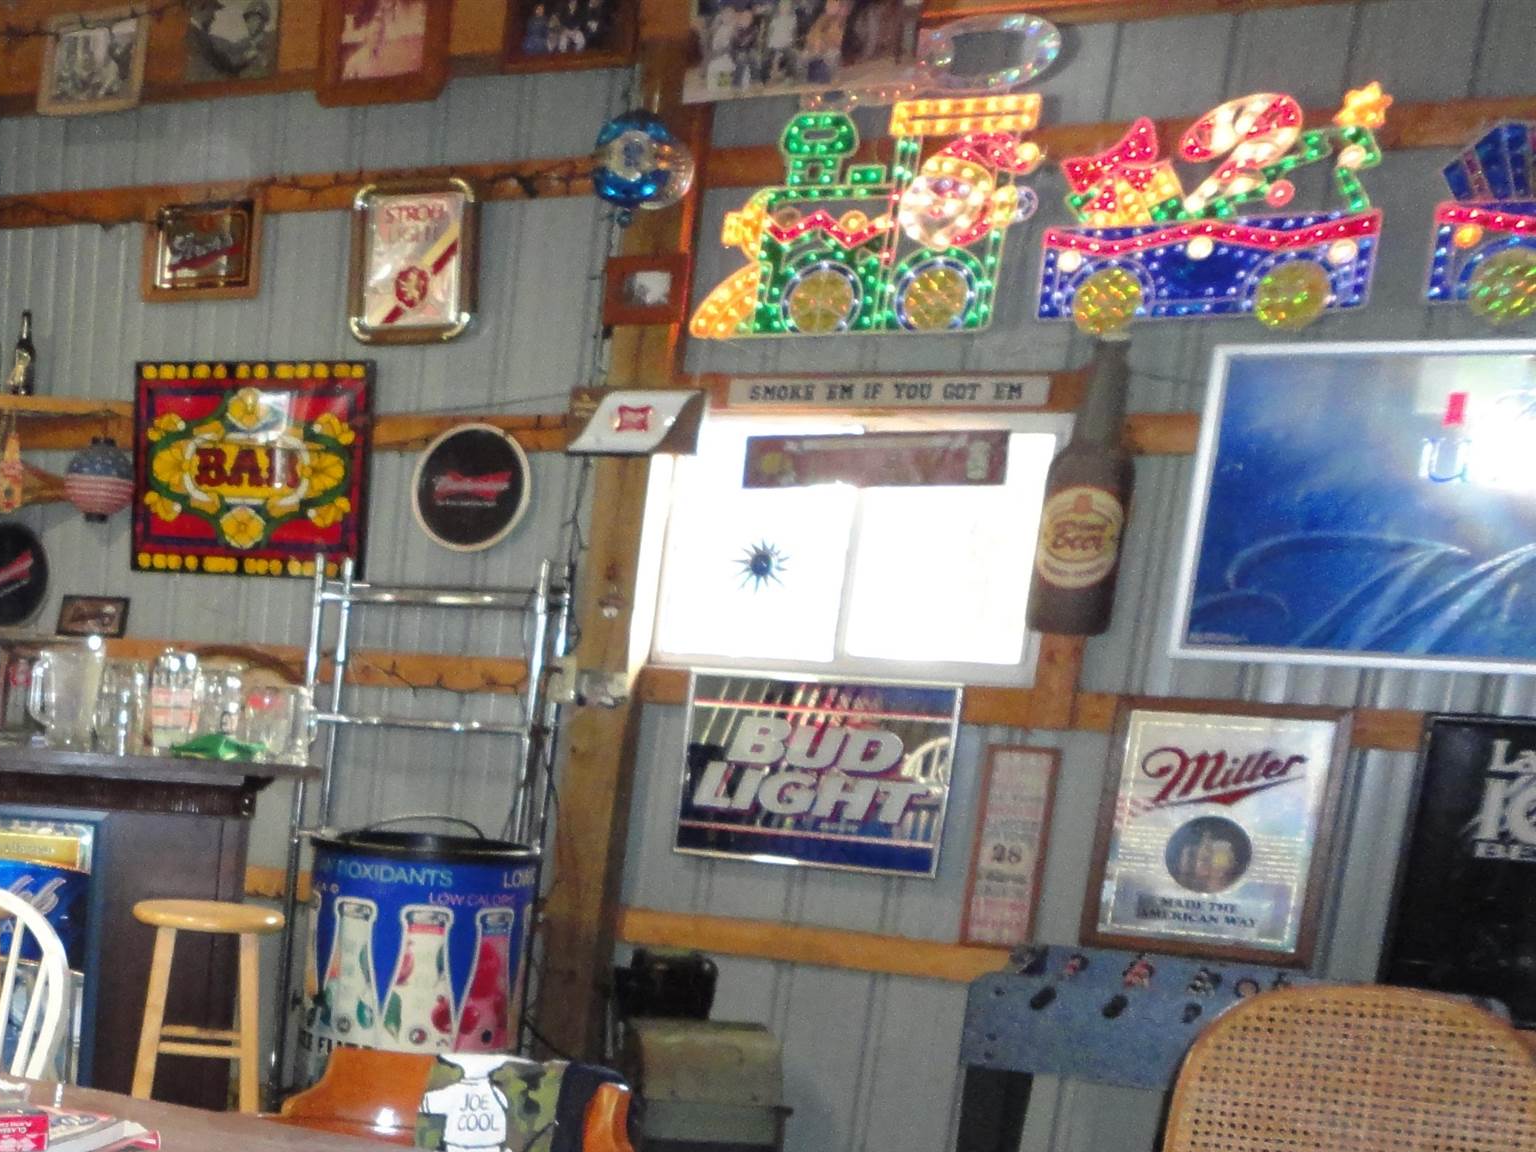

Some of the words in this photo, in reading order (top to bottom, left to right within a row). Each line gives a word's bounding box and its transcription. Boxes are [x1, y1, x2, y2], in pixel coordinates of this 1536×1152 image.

[749, 384, 815, 401] SMOKE
[826, 384, 853, 400] EM
[863, 383, 882, 399] IF
[894, 383, 932, 399] YOU
[943, 382, 982, 400] GOT
[993, 382, 1024, 400] EM
[194, 446, 300, 489] BAR
[725, 715, 904, 773] BUD
[1141, 746, 1307, 803] Miller
[691, 761, 930, 824] LIGHT
[320, 857, 454, 888] TIOXIDANTS
[1141, 908, 1218, 924] AMERICAN
[1224, 915, 1256, 928] WAY
[1163, 897, 1202, 911] MADE
[1208, 901, 1237, 914] THE
[460, 1093, 489, 1111] JOE
[457, 1112, 500, 1132] COOL
